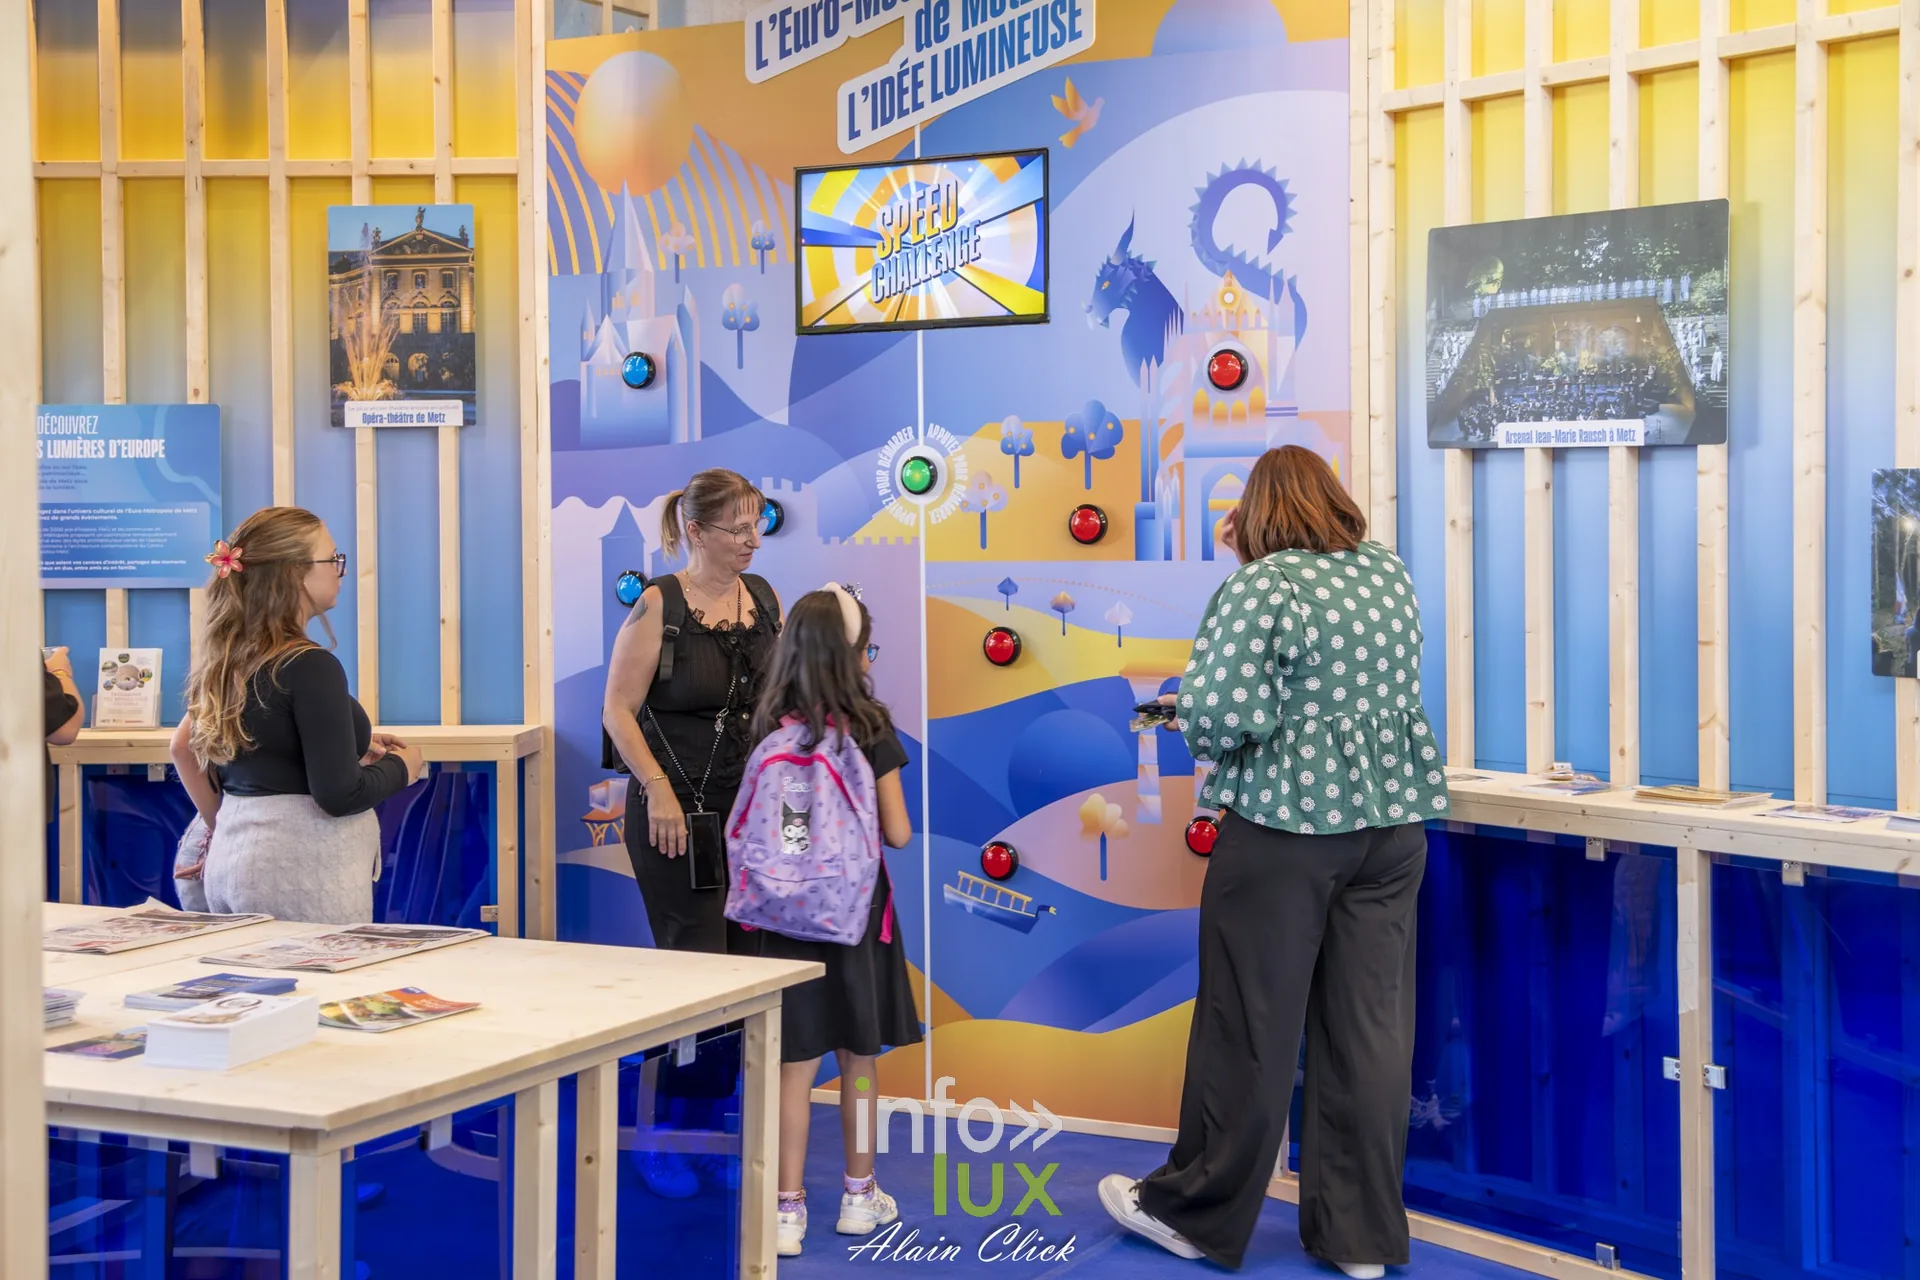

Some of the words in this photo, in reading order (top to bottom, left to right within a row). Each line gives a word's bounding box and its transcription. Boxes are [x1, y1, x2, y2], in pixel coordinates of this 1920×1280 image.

[914, 0, 950, 53] de
[848, 57, 925, 142] L'IDÉE
[931, 0, 1083, 103] LUMINEUSE
[876, 178, 959, 260] SPEED
[871, 219, 982, 304] CHALLENGE
[36, 412, 99, 435] DÉCOUVREZ
[416, 412, 425, 423] de
[427, 411, 446, 423] Metz
[47, 436, 105, 459] LUMIÈRES
[109, 438, 165, 459] D'EUROPE
[877, 426, 915, 468] DÉMARRER
[1505, 429, 1533, 444] Arsenal
[1535, 429, 1577, 443] Jean-Marie
[1578, 428, 1607, 443] Rausch
[1616, 428, 1636, 442] Metz
[876, 469, 892, 496] POUR
